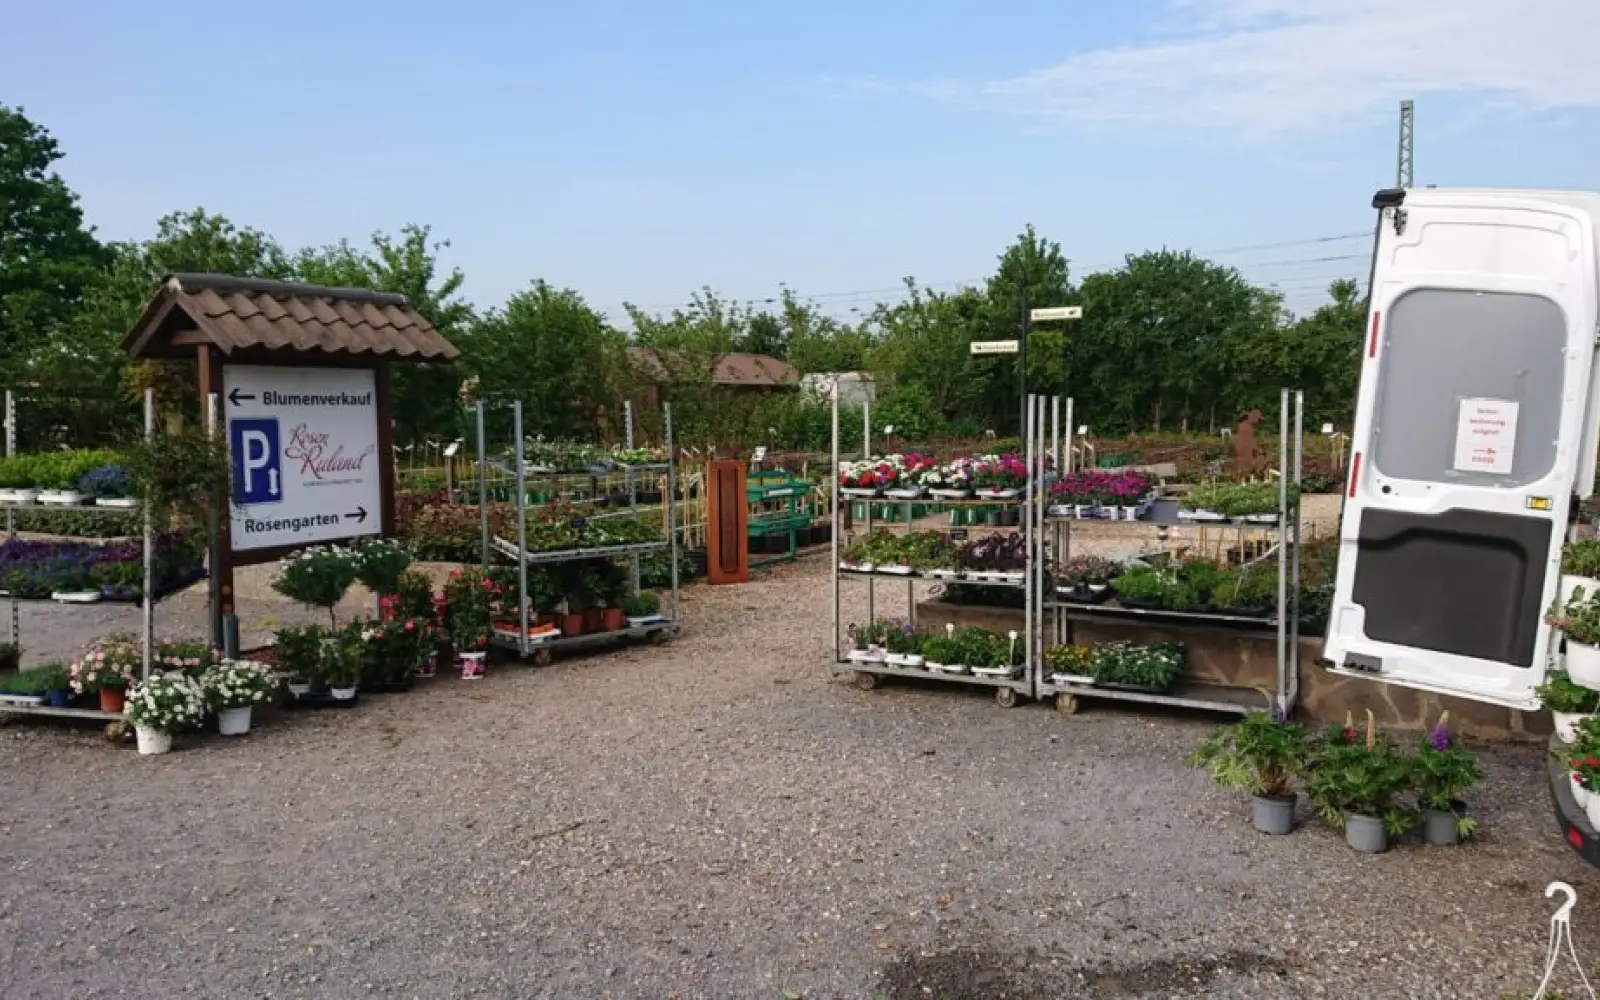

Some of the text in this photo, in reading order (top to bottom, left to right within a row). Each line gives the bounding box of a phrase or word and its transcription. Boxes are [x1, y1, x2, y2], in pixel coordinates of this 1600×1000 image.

[263, 390, 372, 406] Blumenverkauf
[242, 430, 271, 494] P
[244, 513, 340, 534] Rosengarten
